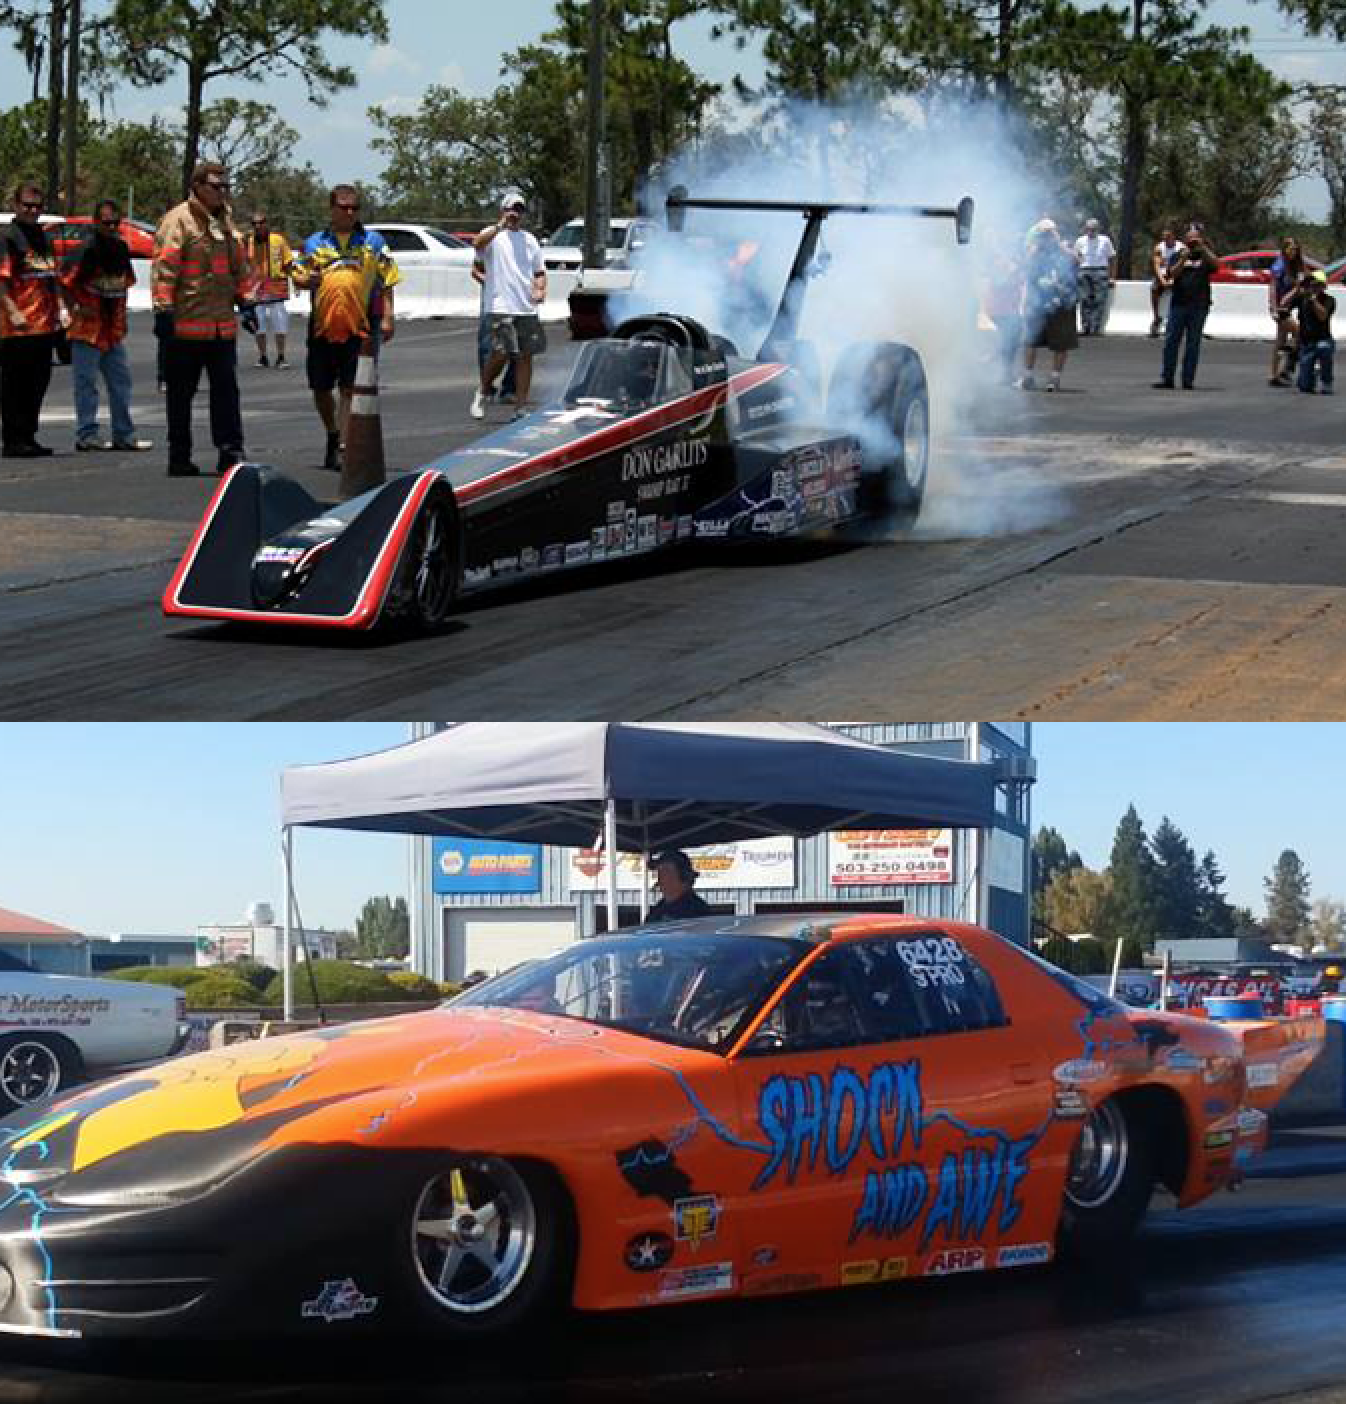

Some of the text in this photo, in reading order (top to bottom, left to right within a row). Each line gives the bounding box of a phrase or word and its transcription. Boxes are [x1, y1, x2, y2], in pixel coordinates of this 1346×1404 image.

[835, 861, 947, 873] 503-250-0498
[895, 937, 963, 966] 6428
[7, 993, 110, 1018] MotorSports
[848, 1140, 1034, 1254] AND AWE
[925, 1249, 985, 1275] ARP
